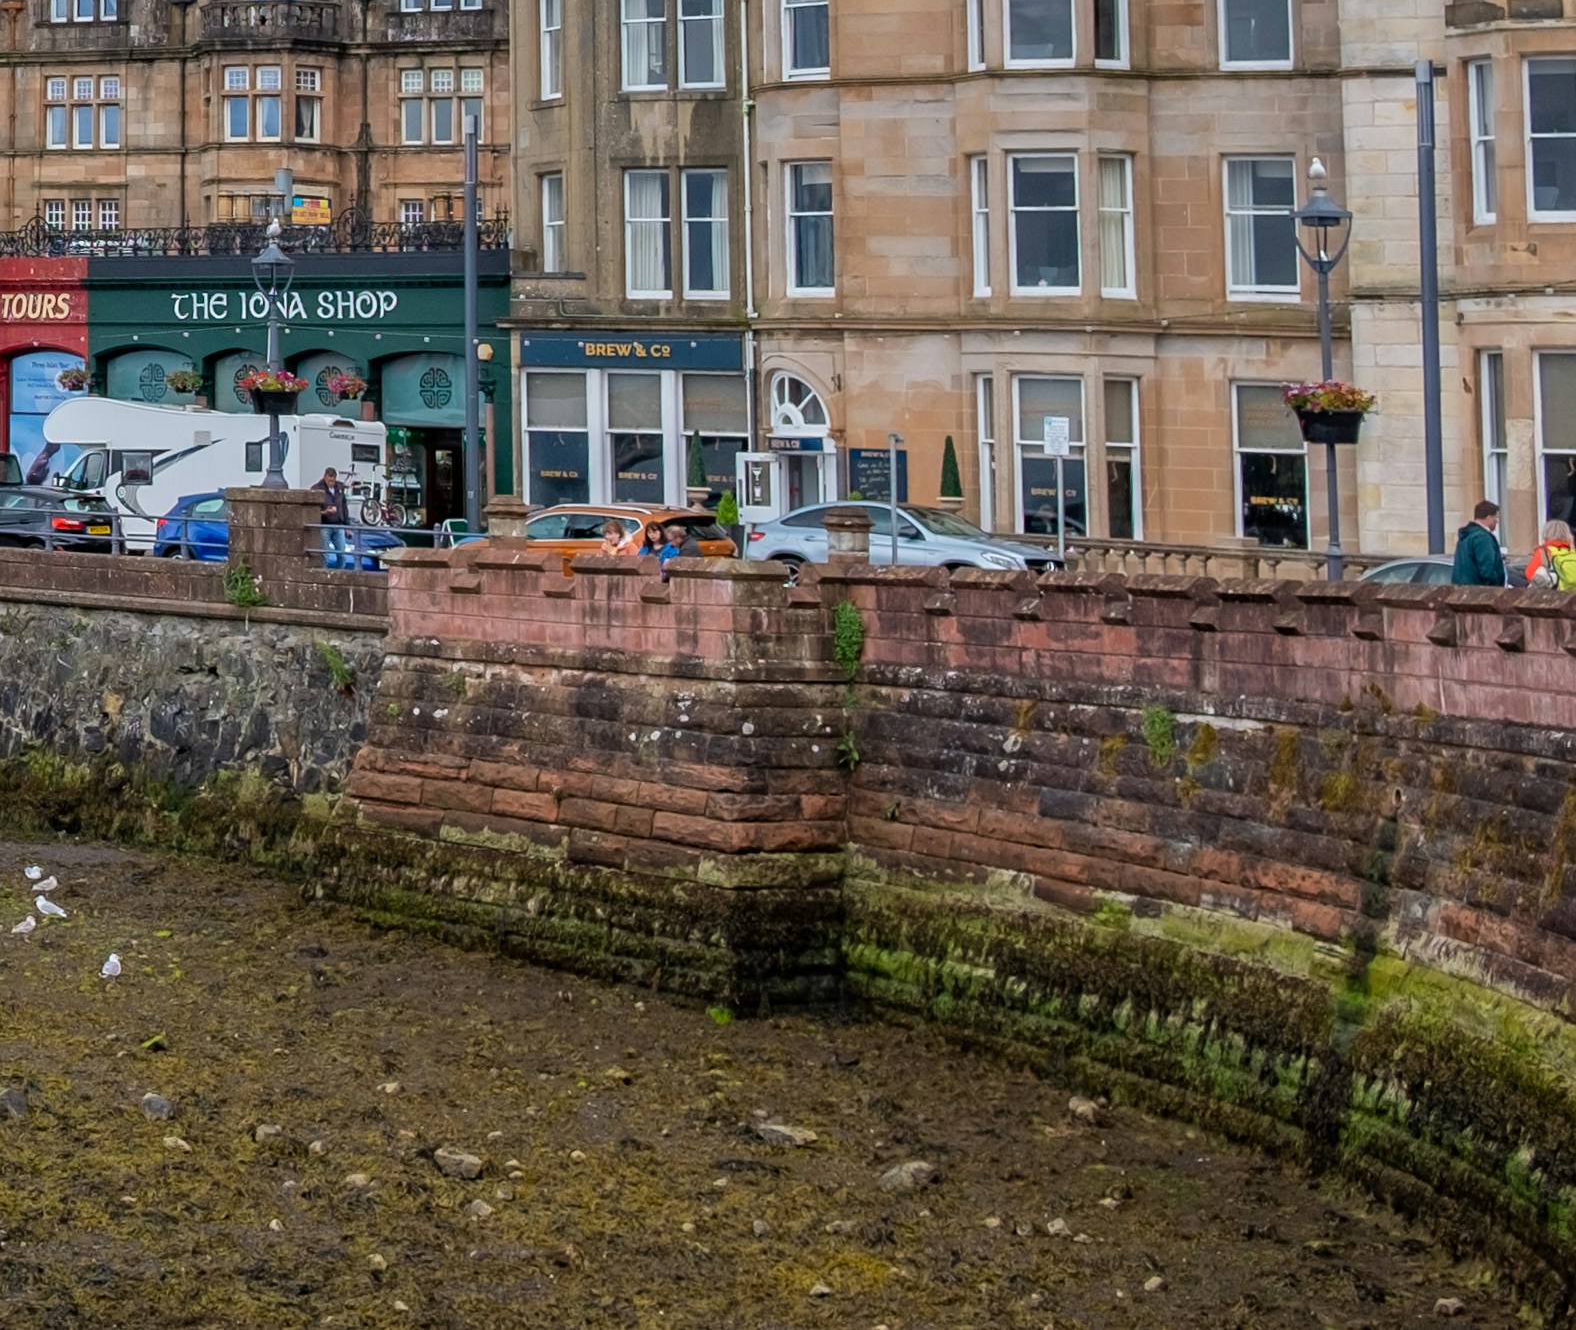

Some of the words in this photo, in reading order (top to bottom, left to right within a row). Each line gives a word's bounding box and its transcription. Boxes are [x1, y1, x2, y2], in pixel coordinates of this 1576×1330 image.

[1, 293, 71, 319] TOURS
[170, 292, 228, 319] THE
[238, 291, 308, 320] IONA
[316, 290, 398, 319] SHOP
[584, 342, 633, 357] BREW
[634, 344, 648, 358] &
